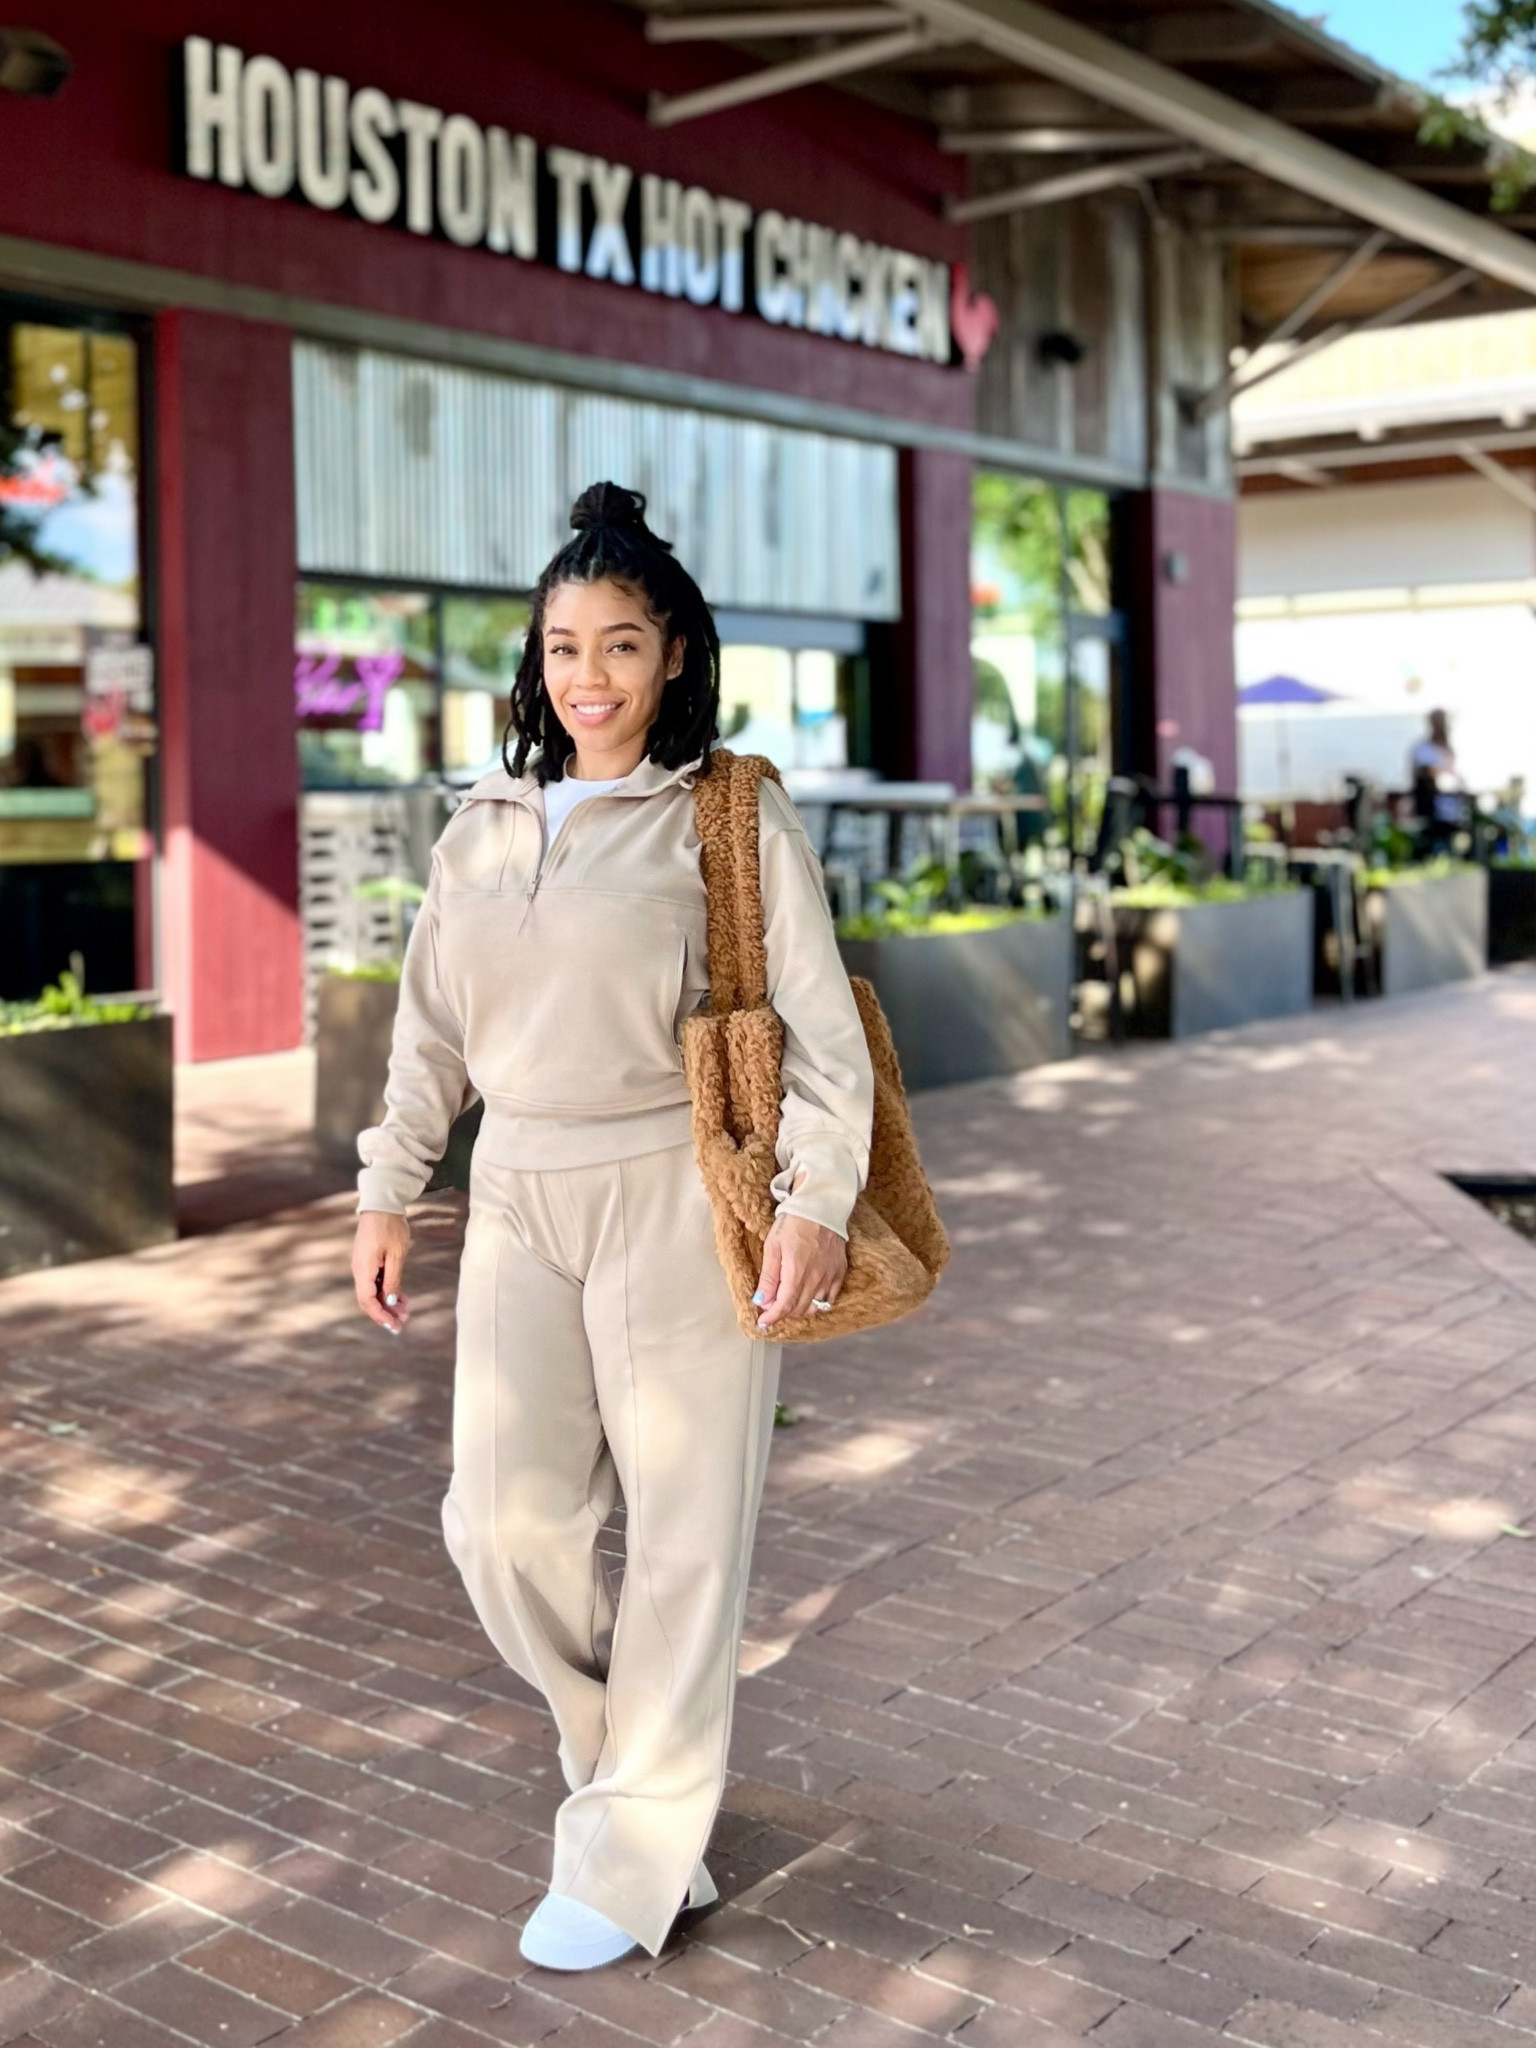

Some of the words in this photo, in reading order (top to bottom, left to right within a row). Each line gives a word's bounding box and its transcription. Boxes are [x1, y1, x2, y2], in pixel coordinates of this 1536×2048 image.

[184, 34, 537, 261] HOUSTON
[548, 147, 635, 285] TX
[640, 173, 752, 313] HOT
[754, 209, 951, 364] CHICKEN
